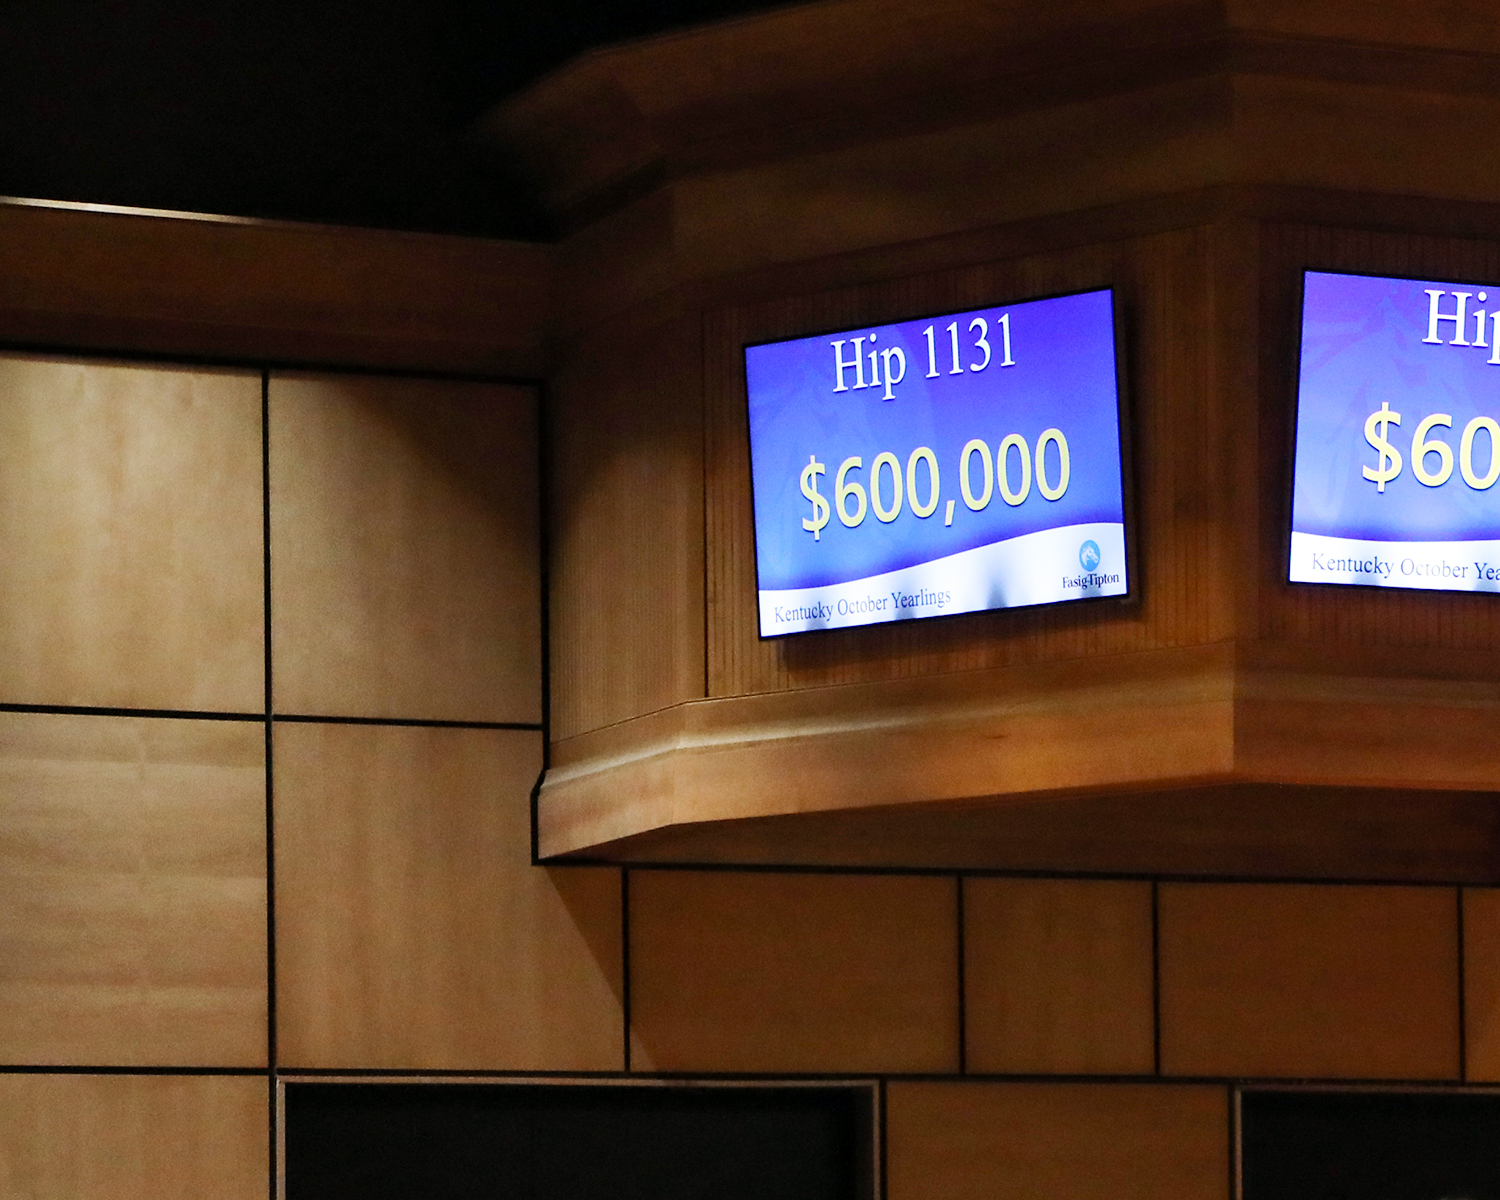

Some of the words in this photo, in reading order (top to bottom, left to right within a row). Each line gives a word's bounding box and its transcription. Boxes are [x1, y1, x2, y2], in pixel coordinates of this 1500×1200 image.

[831, 332, 907, 401] Hip
[922, 313, 1016, 379] 1131
[799, 427, 1071, 541] $600,000
[1062, 573, 1120, 591] Fasig-Tipton
[1312, 552, 1395, 579] Kentucky
[1400, 557, 1469, 579] October
[774, 601, 834, 623] Kentucky
[837, 595, 888, 616] October
[891, 588, 952, 609] Yearlings
